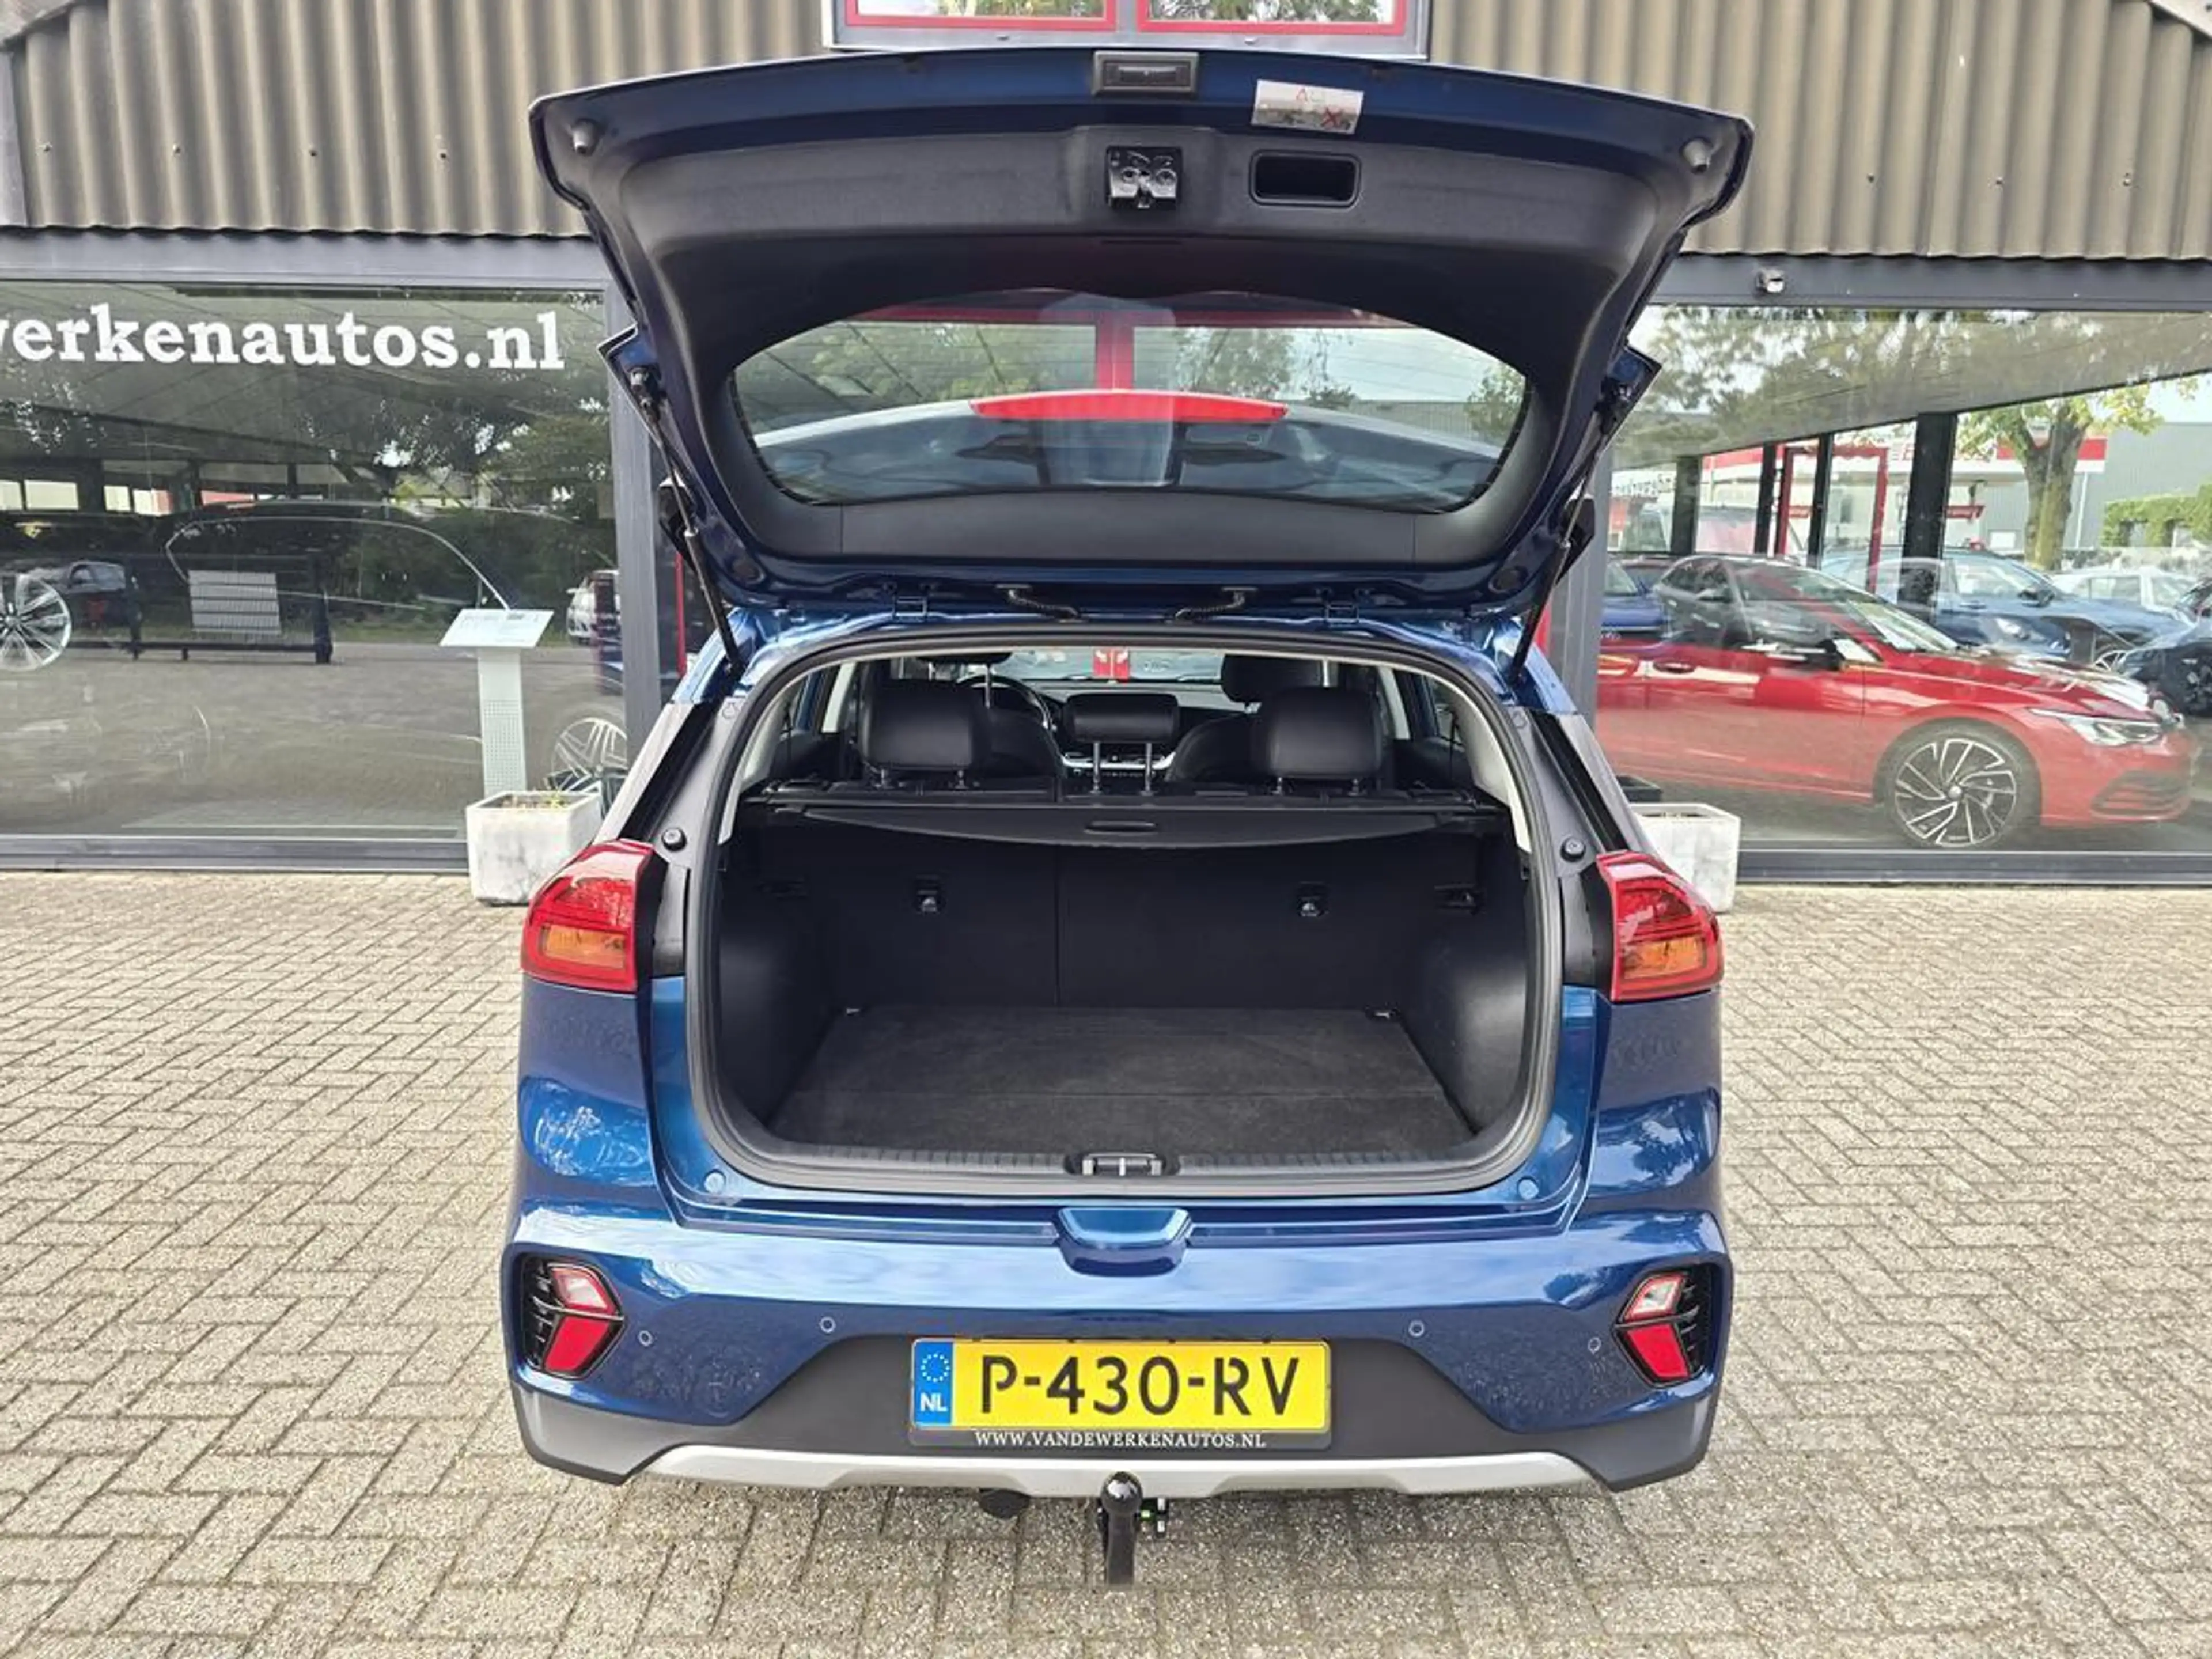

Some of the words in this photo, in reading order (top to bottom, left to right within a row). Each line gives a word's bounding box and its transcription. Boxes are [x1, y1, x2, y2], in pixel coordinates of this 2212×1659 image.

[0, 302, 565, 369] erkenautos.nl
[921, 1392, 948, 1411] NL
[981, 1355, 1300, 1416] P-430-RV
[975, 1431, 1266, 1449] WWW.VANDEWERKENAUTOS.NL
